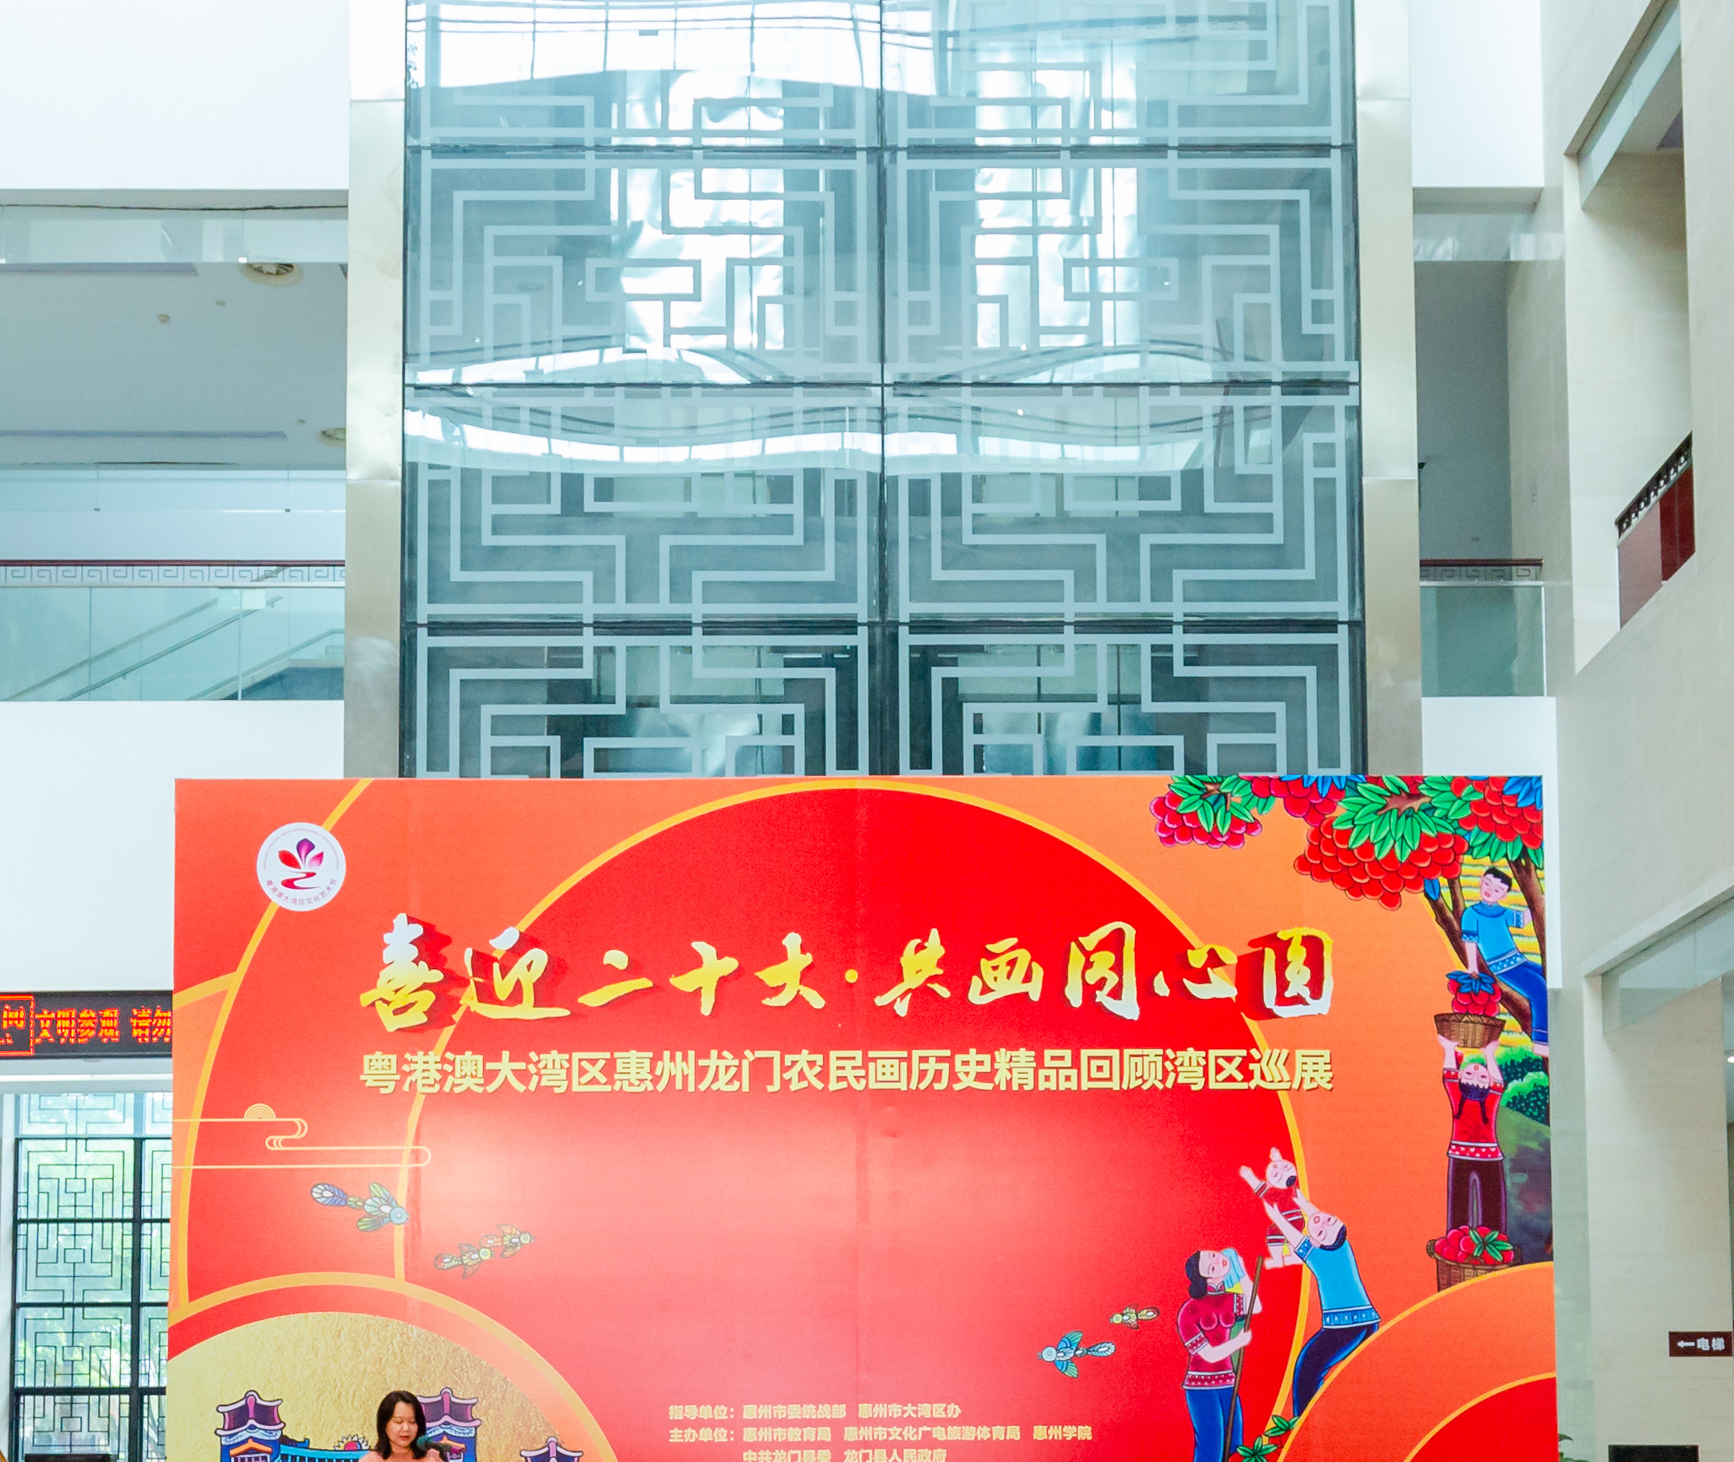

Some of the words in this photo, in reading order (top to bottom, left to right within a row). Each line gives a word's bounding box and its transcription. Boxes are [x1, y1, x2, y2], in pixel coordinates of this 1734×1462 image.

[360, 1048, 1333, 1094] 粤港澳大湾区惠州龙门农民画历史精品回顾湾区巡展
[1697, 1337, 1725, 1351] 电梯
[669, 1404, 735, 1420] 指导单位：
[742, 1404, 846, 1420] 惠州市委统战部
[858, 1403, 962, 1419] 惠州市大湾区办
[669, 1427, 735, 1443] 主办单位：
[742, 1427, 832, 1442] 惠州市教育局
[843, 1426, 1021, 1441] 惠州市文化广电旅游体育局
[1033, 1425, 1092, 1441] 惠州学院
